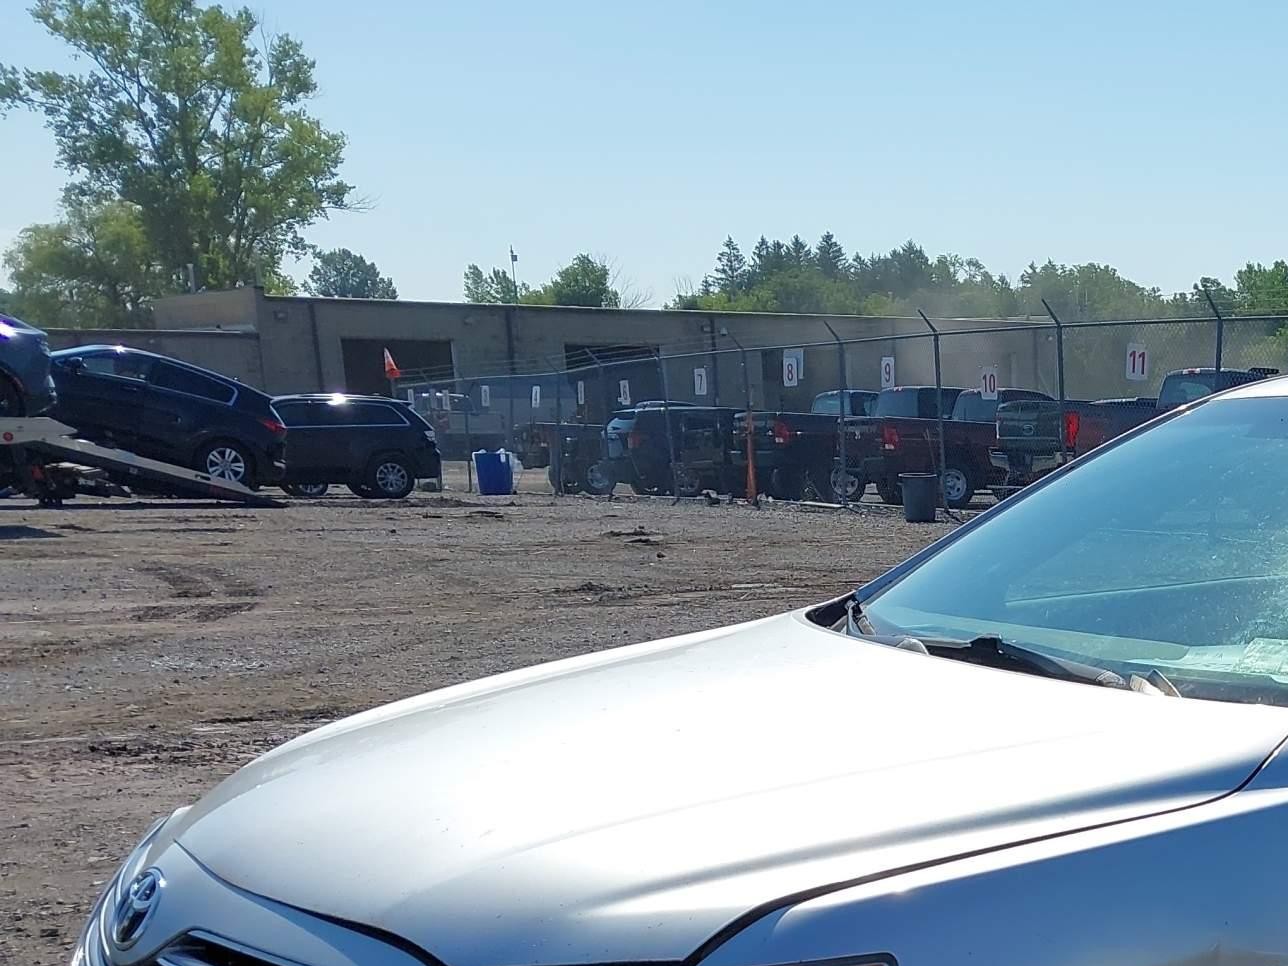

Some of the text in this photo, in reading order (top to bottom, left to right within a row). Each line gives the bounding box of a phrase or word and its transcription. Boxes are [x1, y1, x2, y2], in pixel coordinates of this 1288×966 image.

[786, 362, 794, 382] 8
[884, 362, 891, 383] 9
[1128, 350, 1146, 376] 11
[696, 373, 703, 392] 7
[982, 373, 997, 394] 10
